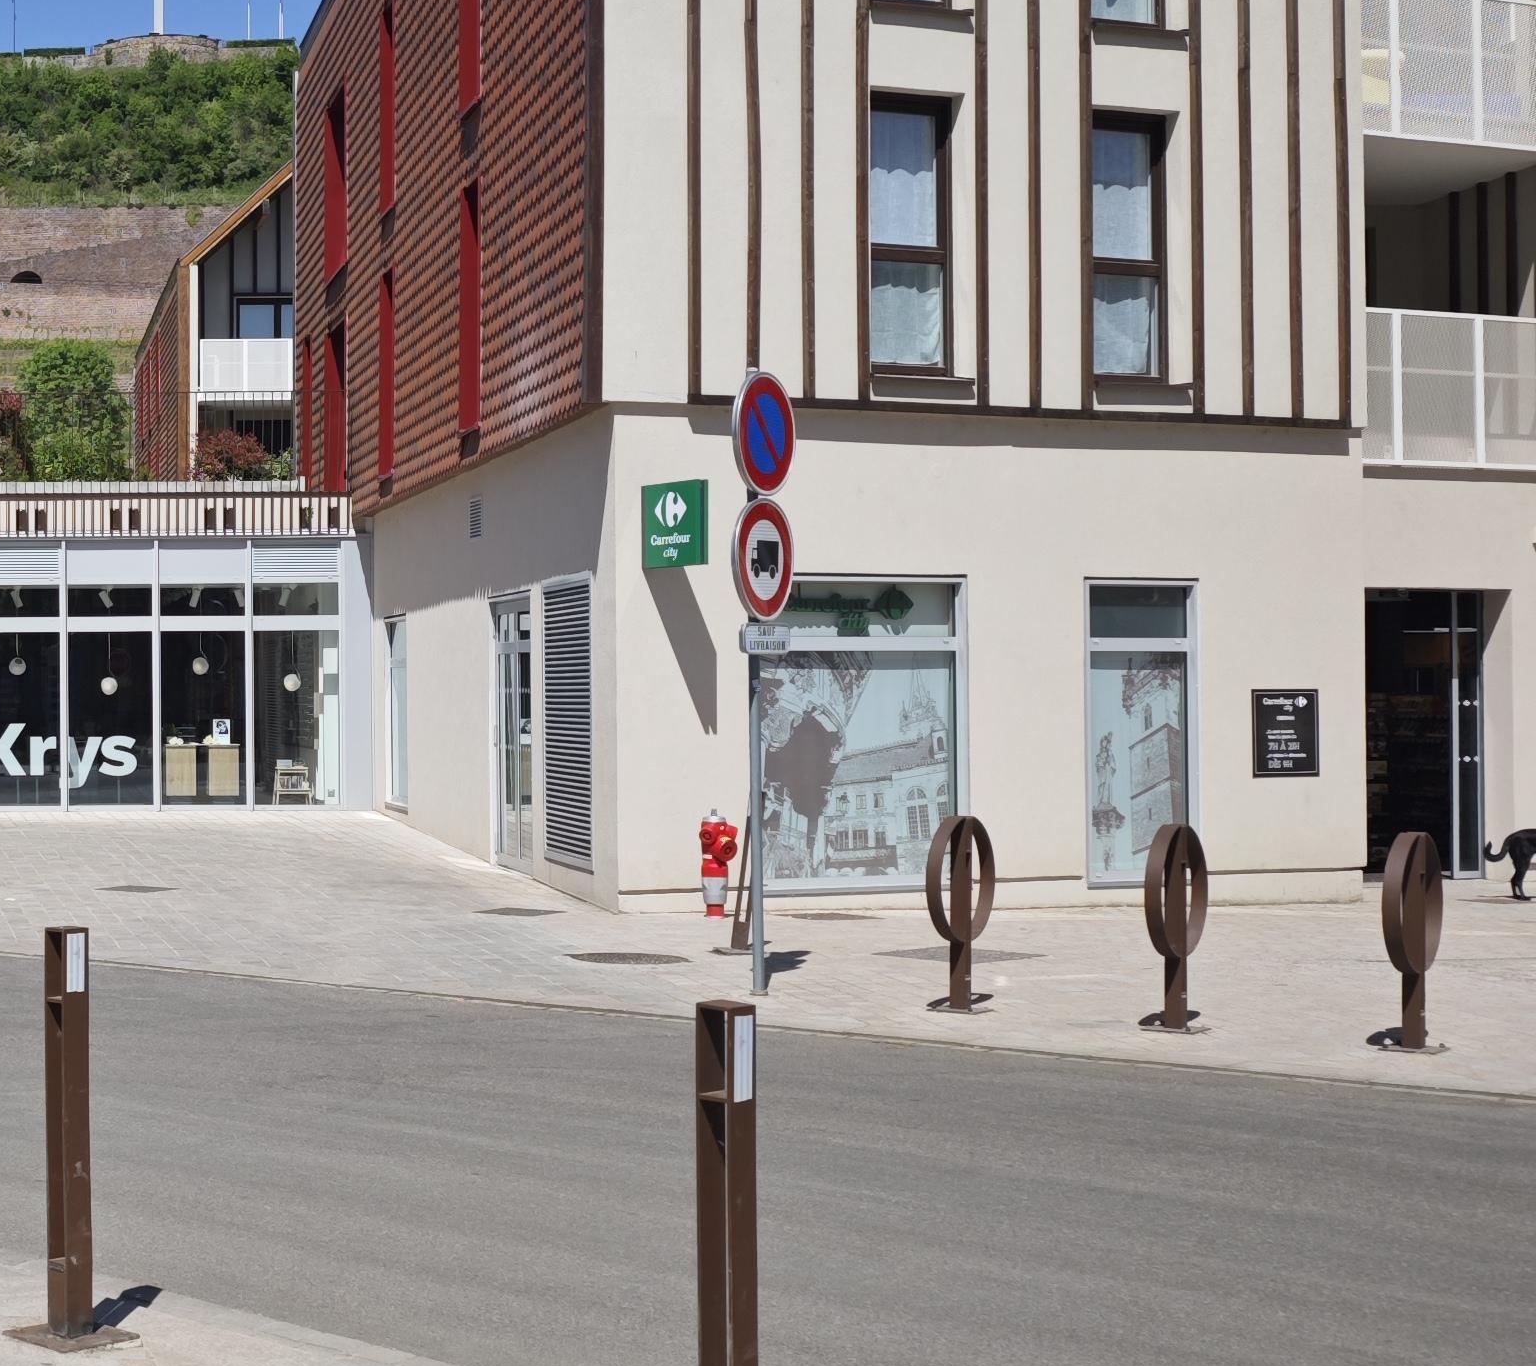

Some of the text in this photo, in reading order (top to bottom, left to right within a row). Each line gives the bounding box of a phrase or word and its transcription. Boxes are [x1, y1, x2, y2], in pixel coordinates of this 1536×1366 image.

[650, 532, 691, 546] Carrefour
[663, 547, 679, 561] city
[757, 626, 776, 636] SAUF
[749, 641, 786, 650] LIVRAISON
